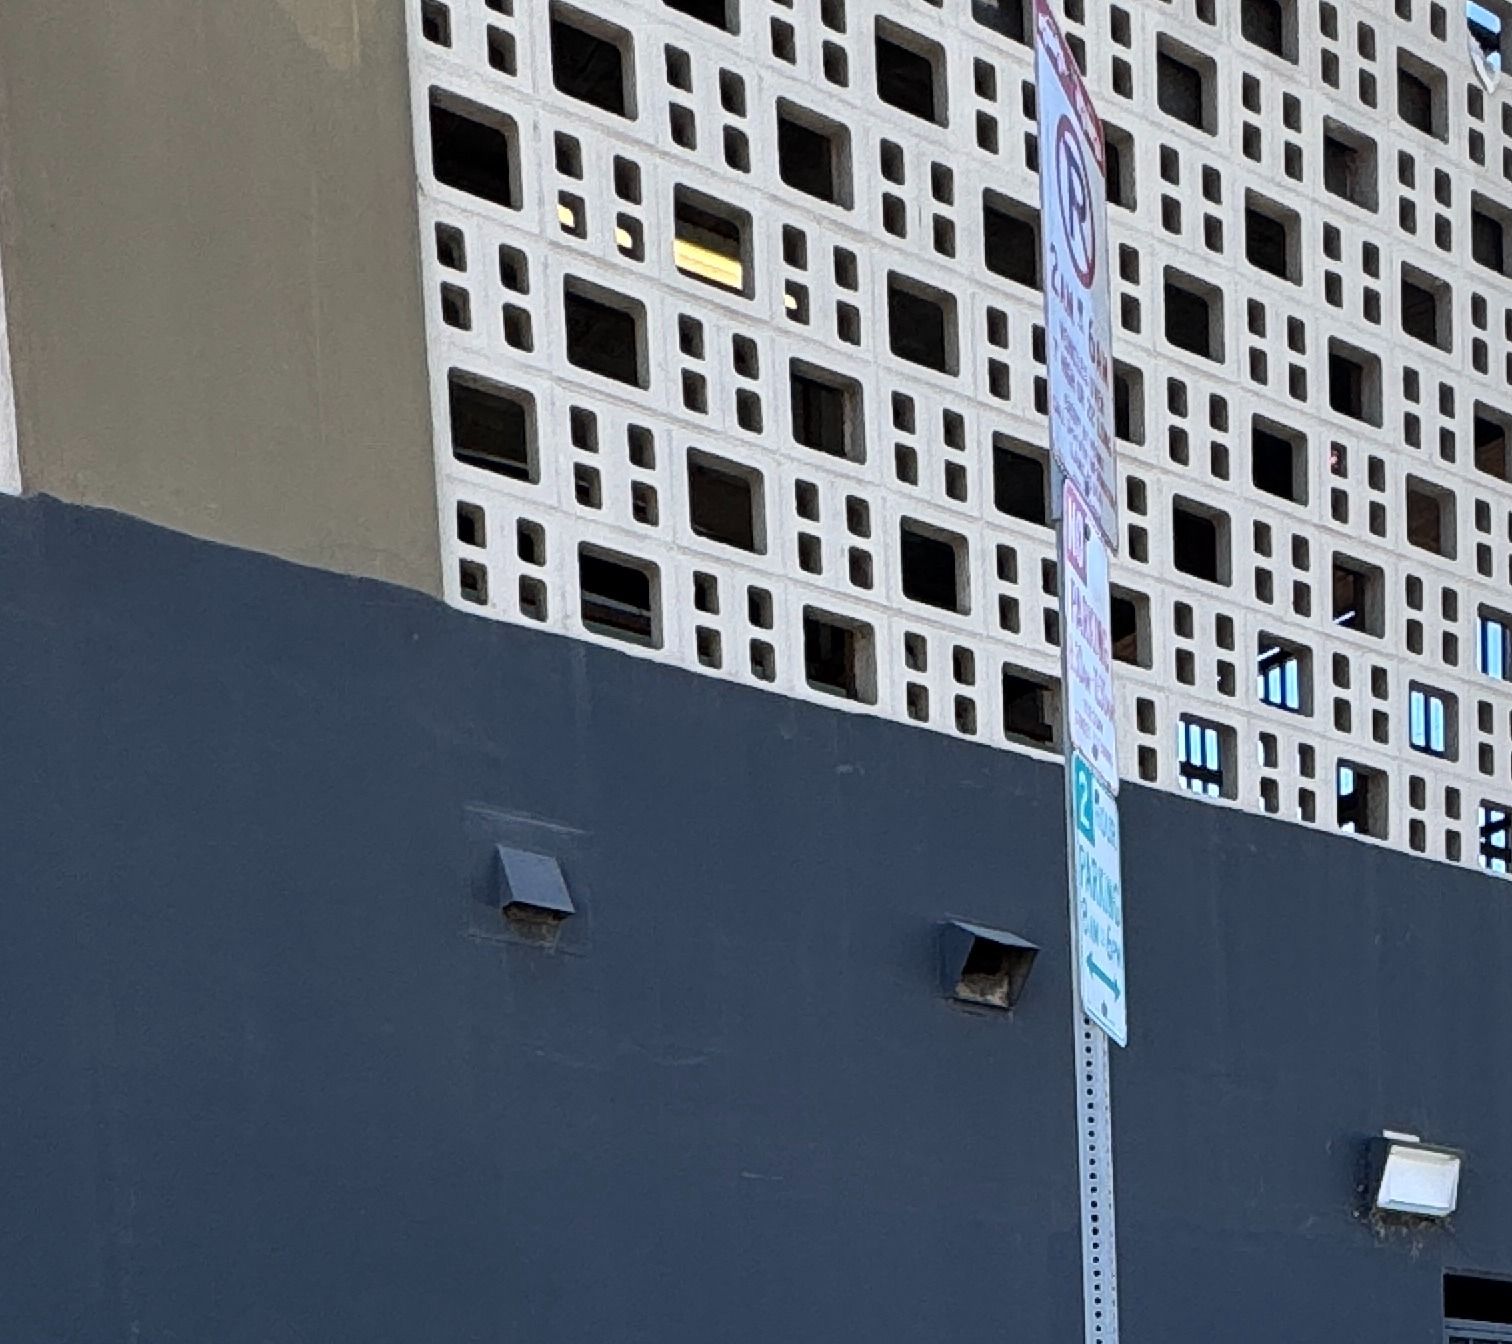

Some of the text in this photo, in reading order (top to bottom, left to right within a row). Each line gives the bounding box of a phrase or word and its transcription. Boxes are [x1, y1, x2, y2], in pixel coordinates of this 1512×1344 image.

[1070, 577, 1111, 674] PARKING
[1078, 770, 1091, 831] 2
[1079, 844, 1120, 928] PARKING
